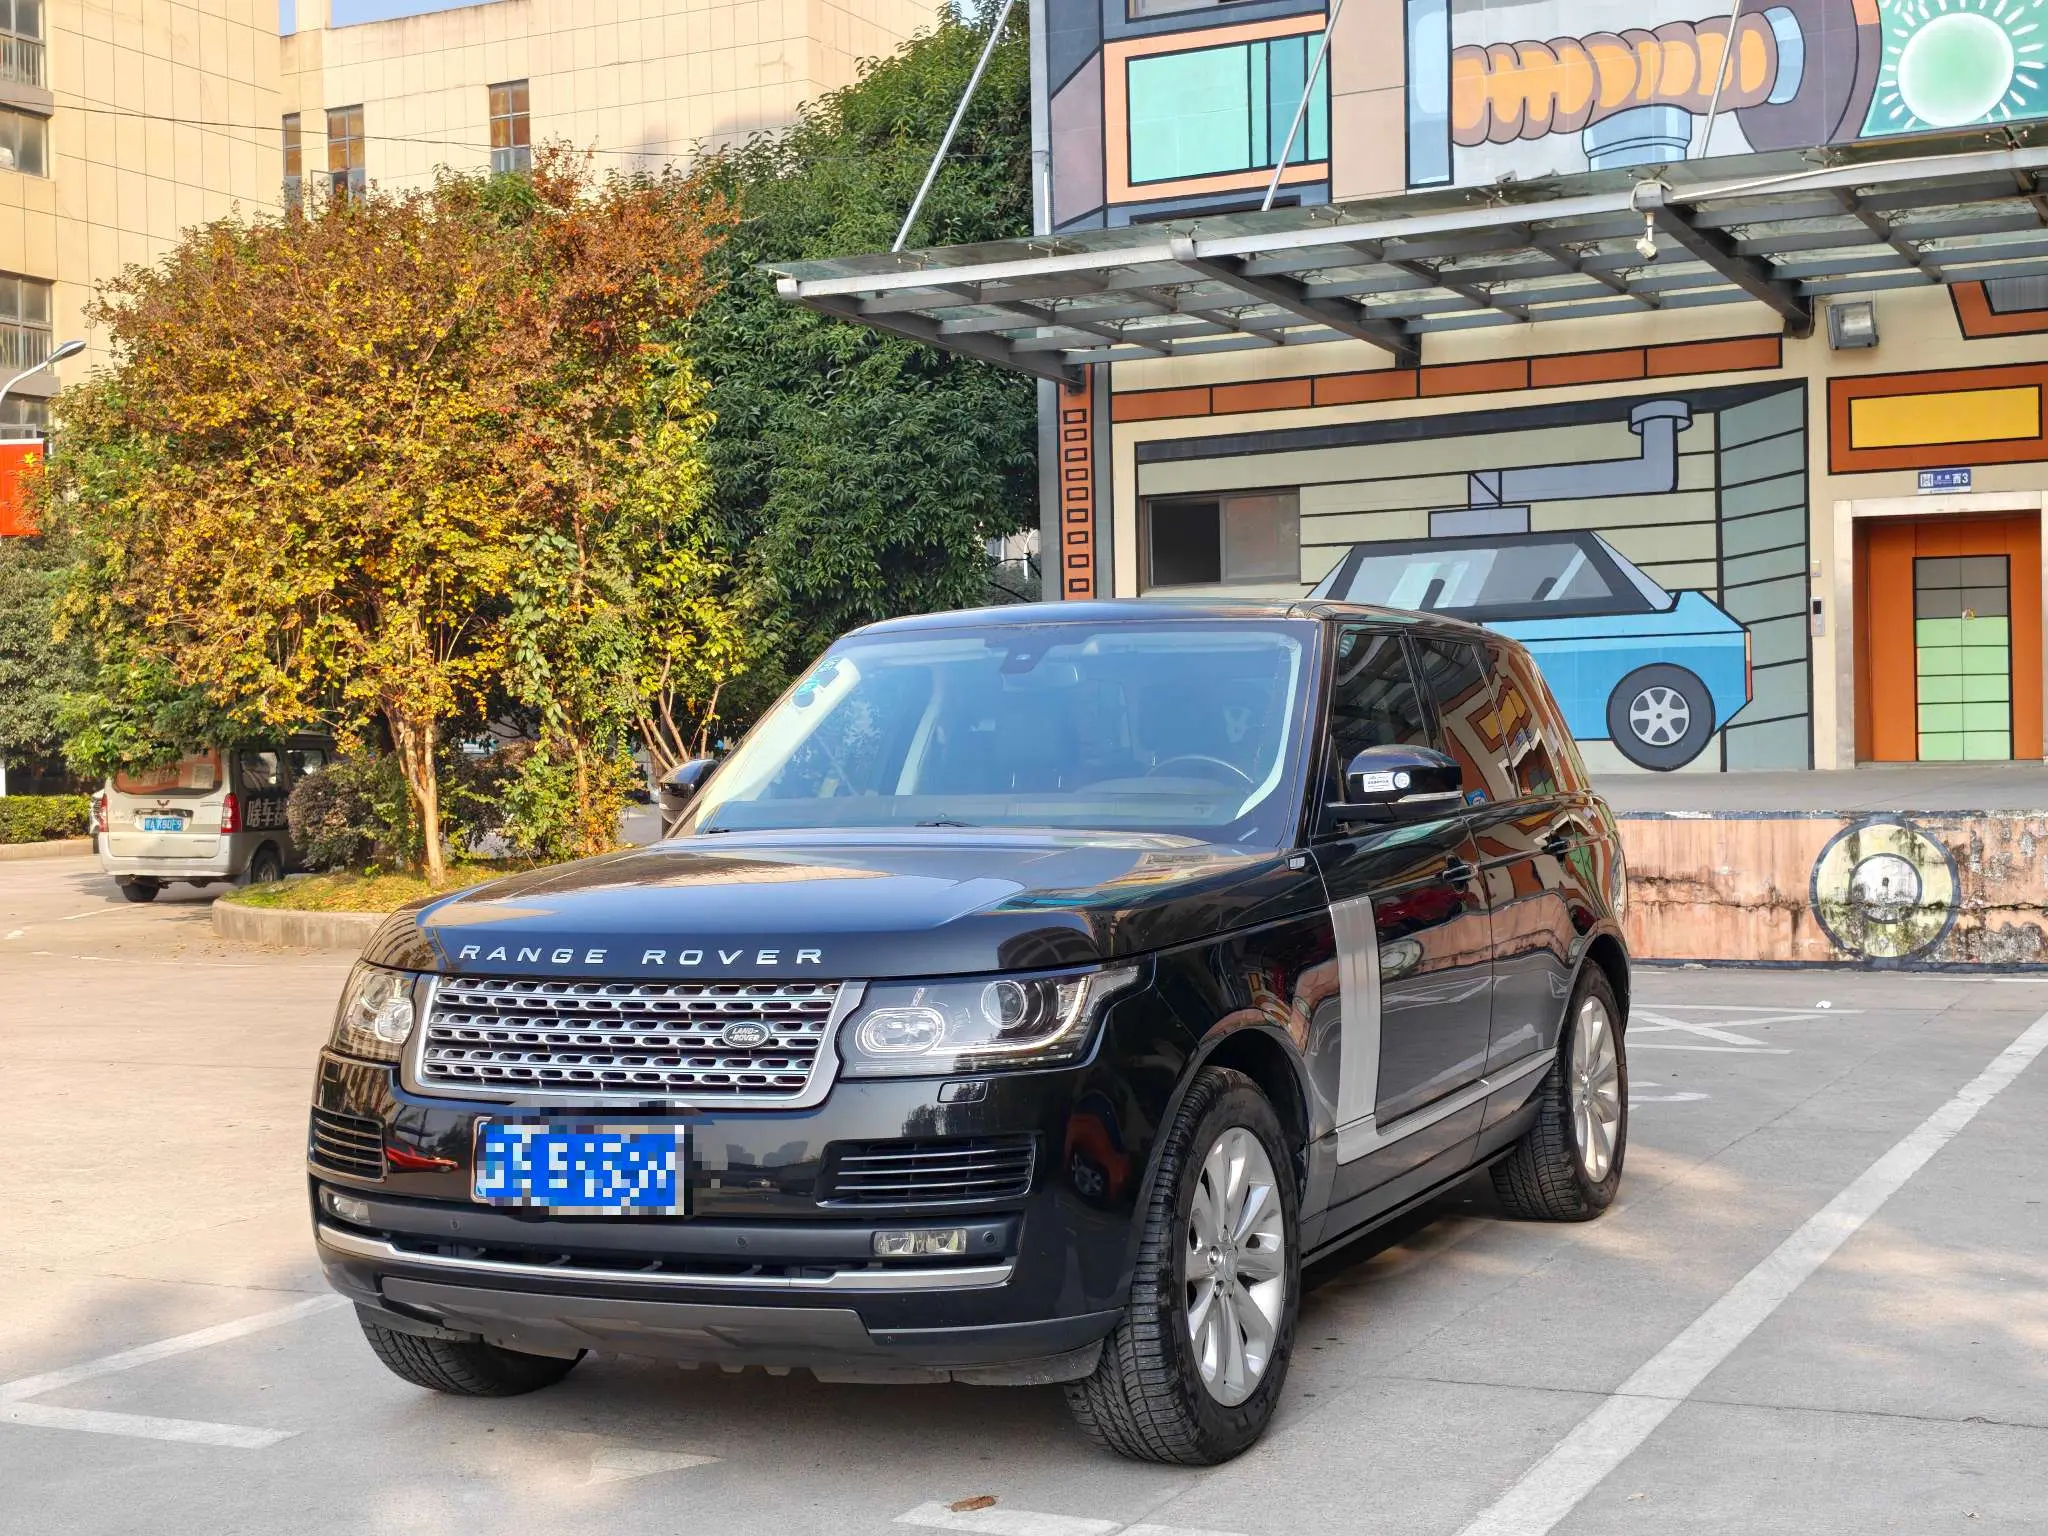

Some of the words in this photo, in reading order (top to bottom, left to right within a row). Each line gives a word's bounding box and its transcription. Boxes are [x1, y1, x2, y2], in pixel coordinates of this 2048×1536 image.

[458, 944, 609, 965] RANGE
[641, 948, 823, 966] ROVER
[732, 1027, 755, 1035] LAND
[733, 1034, 760, 1042] ROVER
